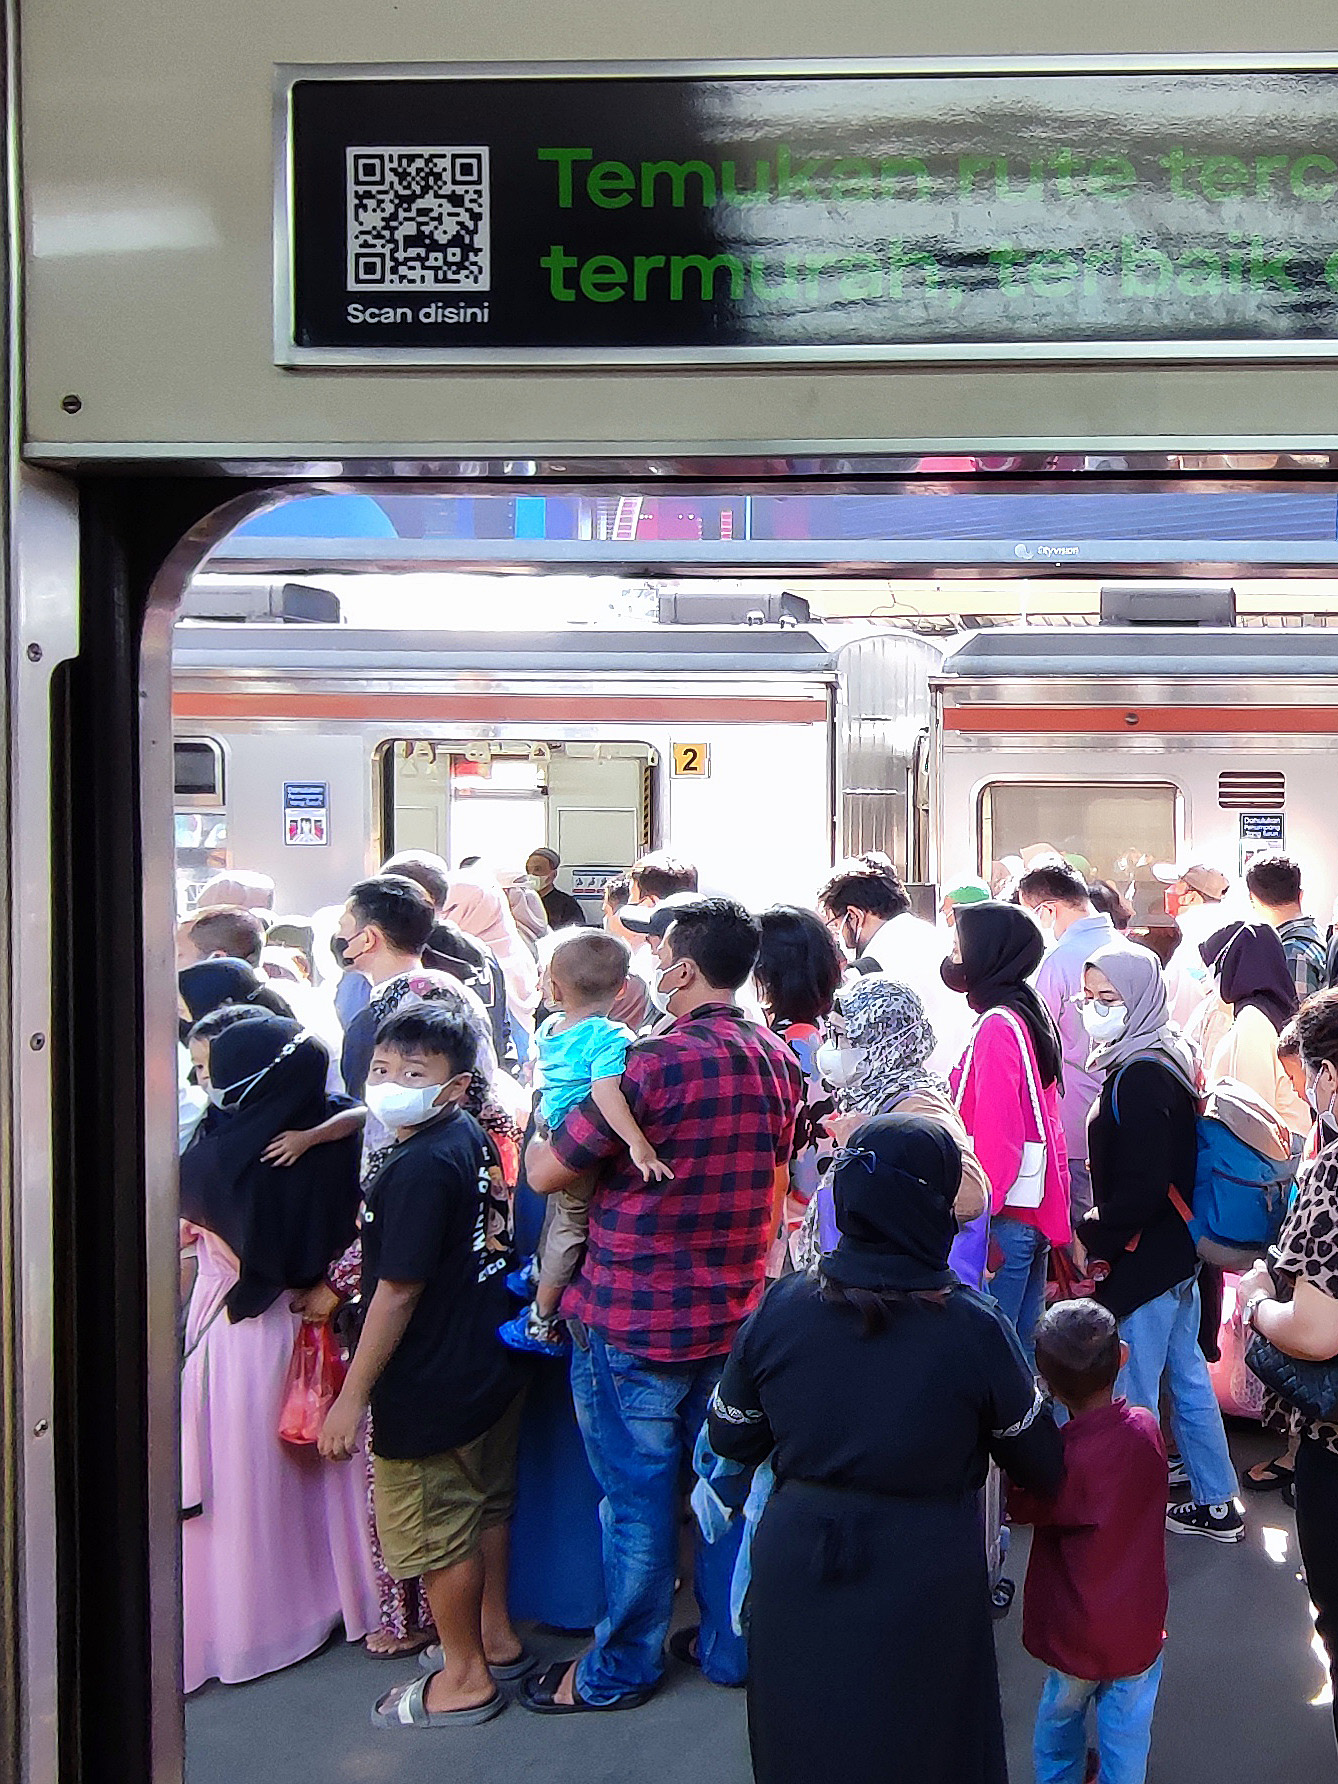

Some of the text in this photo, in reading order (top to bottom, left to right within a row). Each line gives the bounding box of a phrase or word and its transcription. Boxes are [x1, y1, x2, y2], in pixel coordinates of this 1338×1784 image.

[536, 144, 930, 210] Temukan
[957, 146, 1136, 201] rute
[539, 239, 962, 309] termurah,
[989, 232, 1301, 298] terbaik
[347, 302, 489, 324] Scan disini
[682, 748, 698, 772] 2
